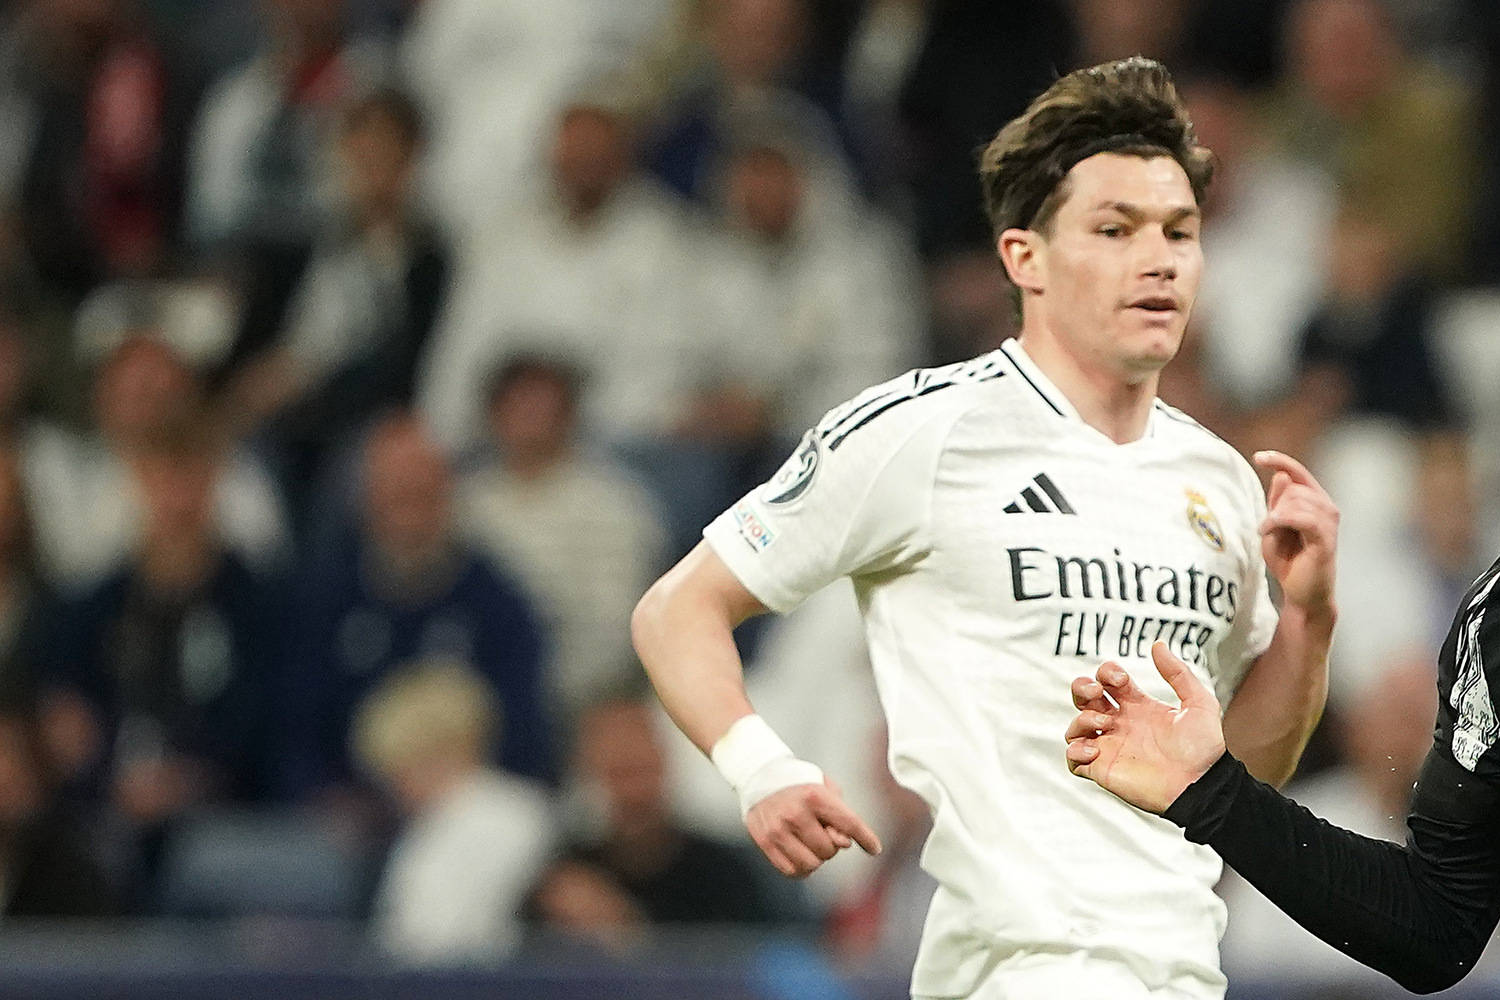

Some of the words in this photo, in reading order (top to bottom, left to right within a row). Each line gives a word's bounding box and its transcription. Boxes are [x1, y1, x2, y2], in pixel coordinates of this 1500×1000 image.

[1006, 548, 1237, 624] Emirates
[1054, 613, 1108, 657] FLY
[1118, 615, 1214, 665] BETTER
